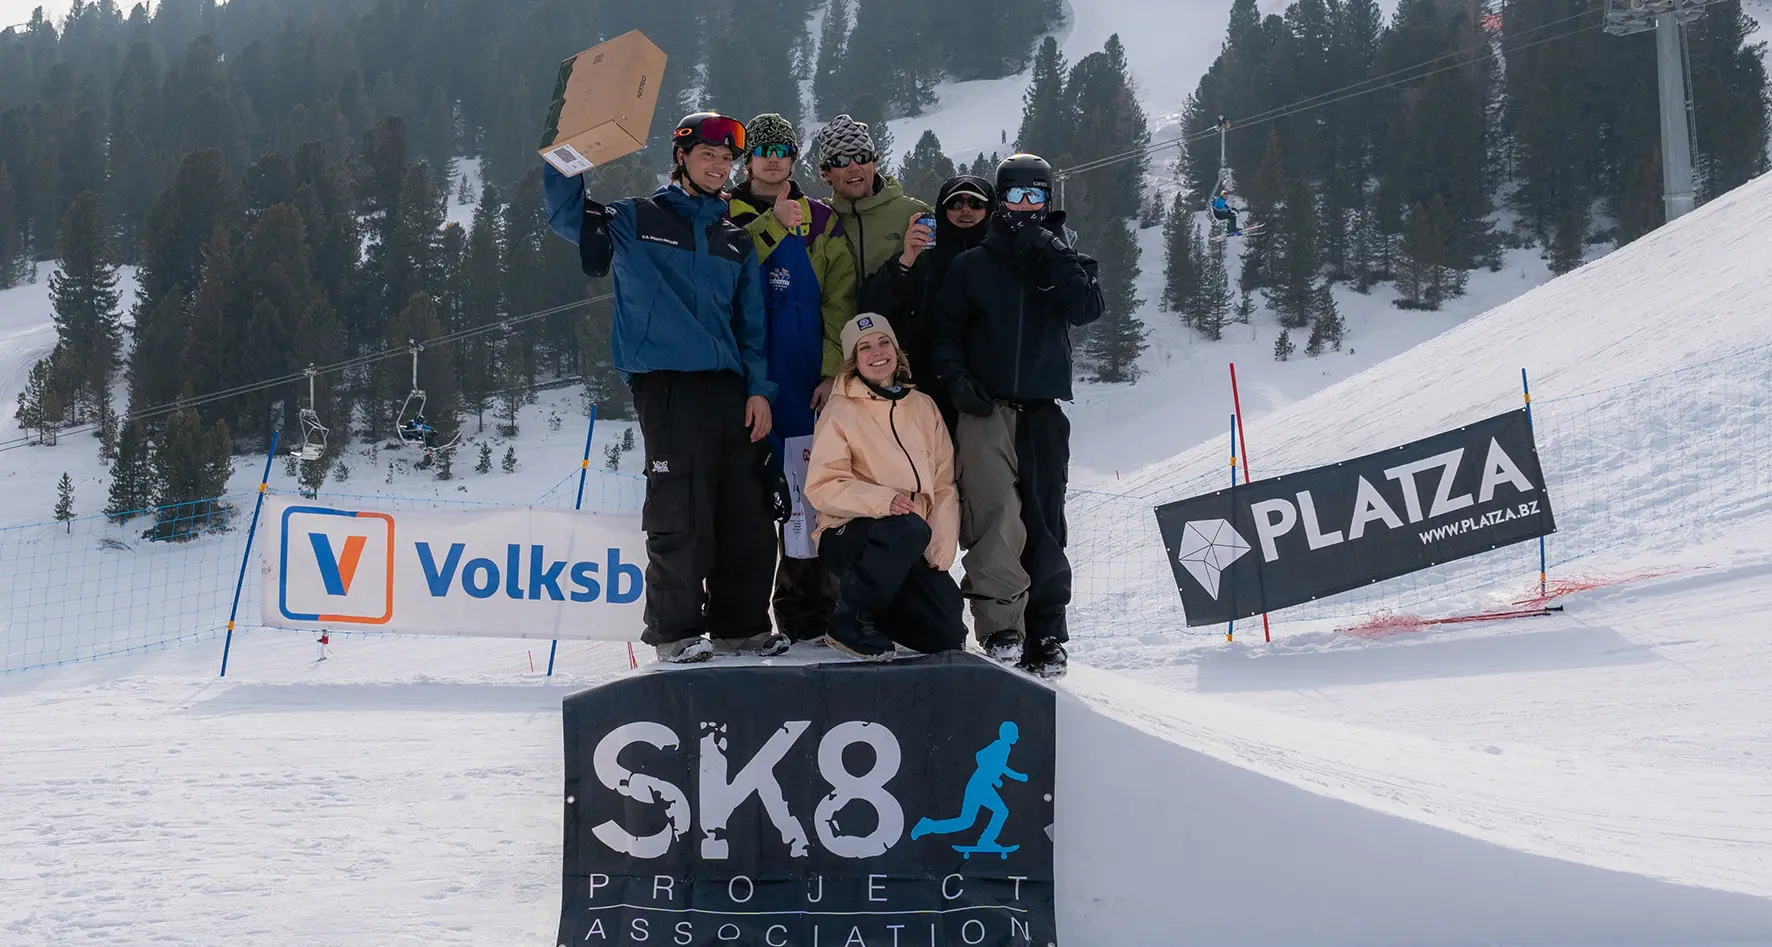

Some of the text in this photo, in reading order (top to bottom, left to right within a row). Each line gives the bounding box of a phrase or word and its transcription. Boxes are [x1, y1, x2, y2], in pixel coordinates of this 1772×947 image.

[636, 75, 647, 100] NITRO
[1250, 436, 1534, 563] PLATZA
[1419, 500, 1540, 545] WWW.PLATZA.BZ
[415, 541, 645, 604] Volksb
[591, 720, 905, 860] SK8
[589, 873, 1029, 903] PROJECT
[584, 916, 1030, 947] ASSOCIATION
